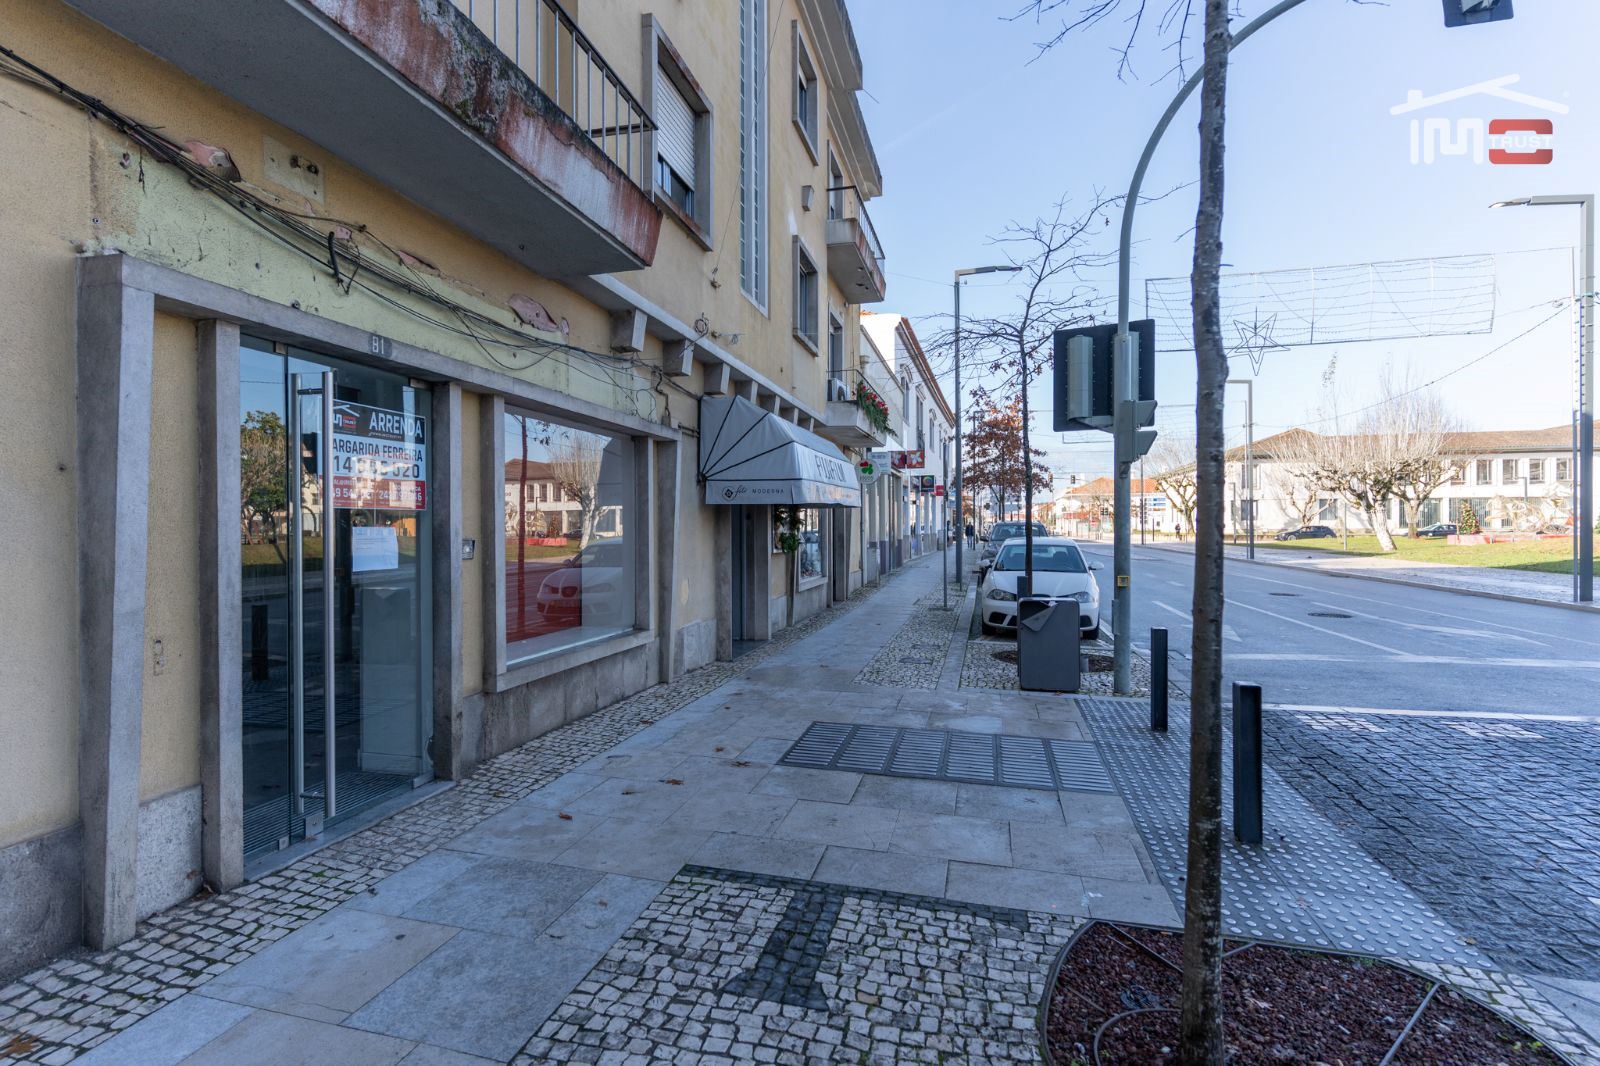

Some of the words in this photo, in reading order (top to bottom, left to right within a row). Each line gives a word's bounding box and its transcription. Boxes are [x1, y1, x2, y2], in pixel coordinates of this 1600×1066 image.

[372, 336, 384, 355] 81
[369, 411, 423, 438] ARRENDA
[333, 438, 380, 457] ARGARIDA
[382, 445, 423, 463] FERREIRA
